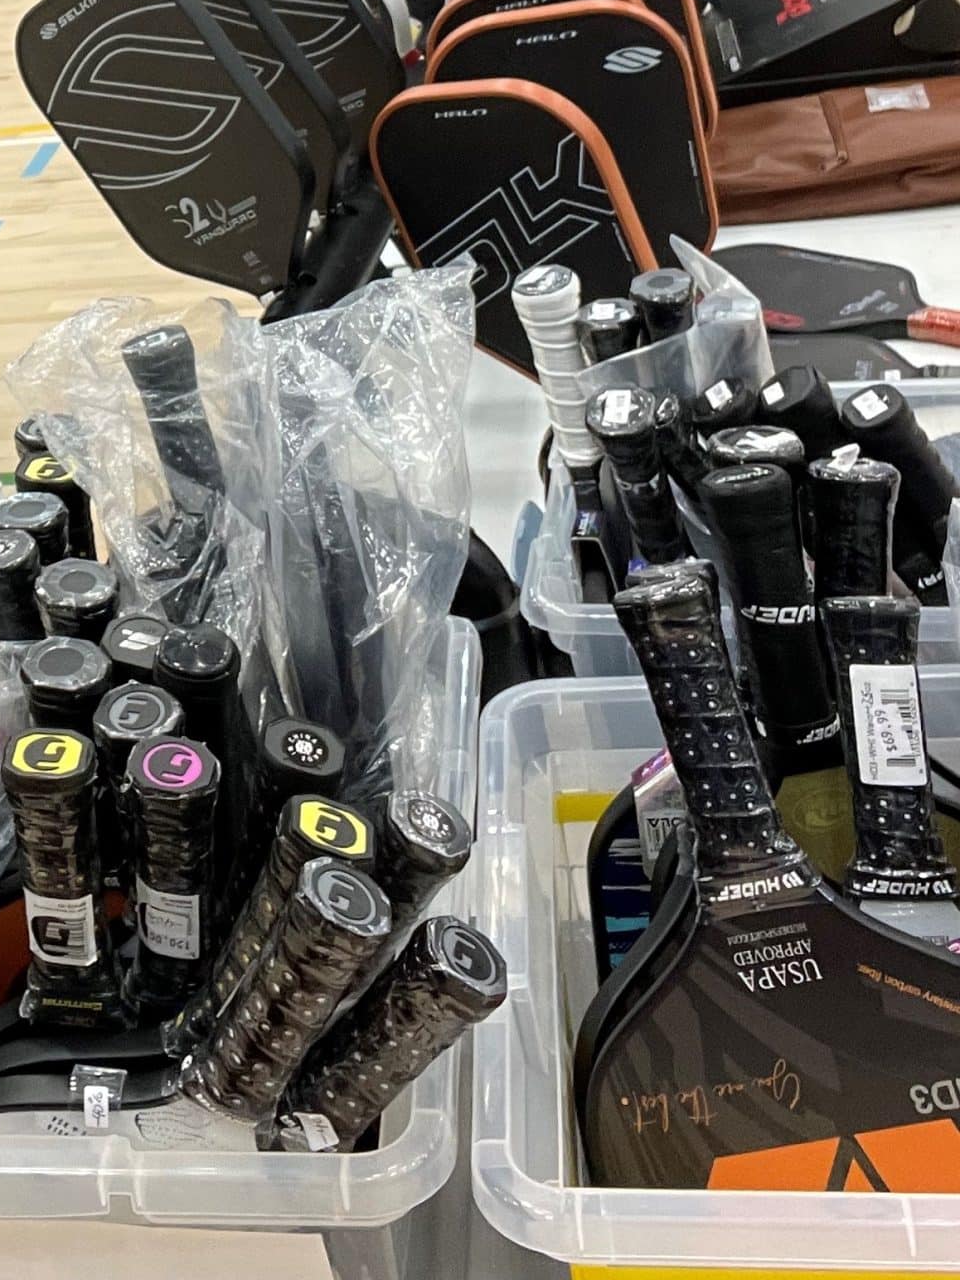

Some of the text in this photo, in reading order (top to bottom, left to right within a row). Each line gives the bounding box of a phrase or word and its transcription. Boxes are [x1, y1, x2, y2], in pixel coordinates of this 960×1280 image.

[516, 30, 578, 46] HALO
[434, 108, 488, 119] HALO
[874, 709, 898, 753] $69.99
[717, 877, 781, 902] HUDEF
[862, 879, 931, 895] HUDEF
[733, 938, 812, 967] APPROVED
[737, 958, 824, 993] USAPA
[677, 1086, 718, 1126] the
